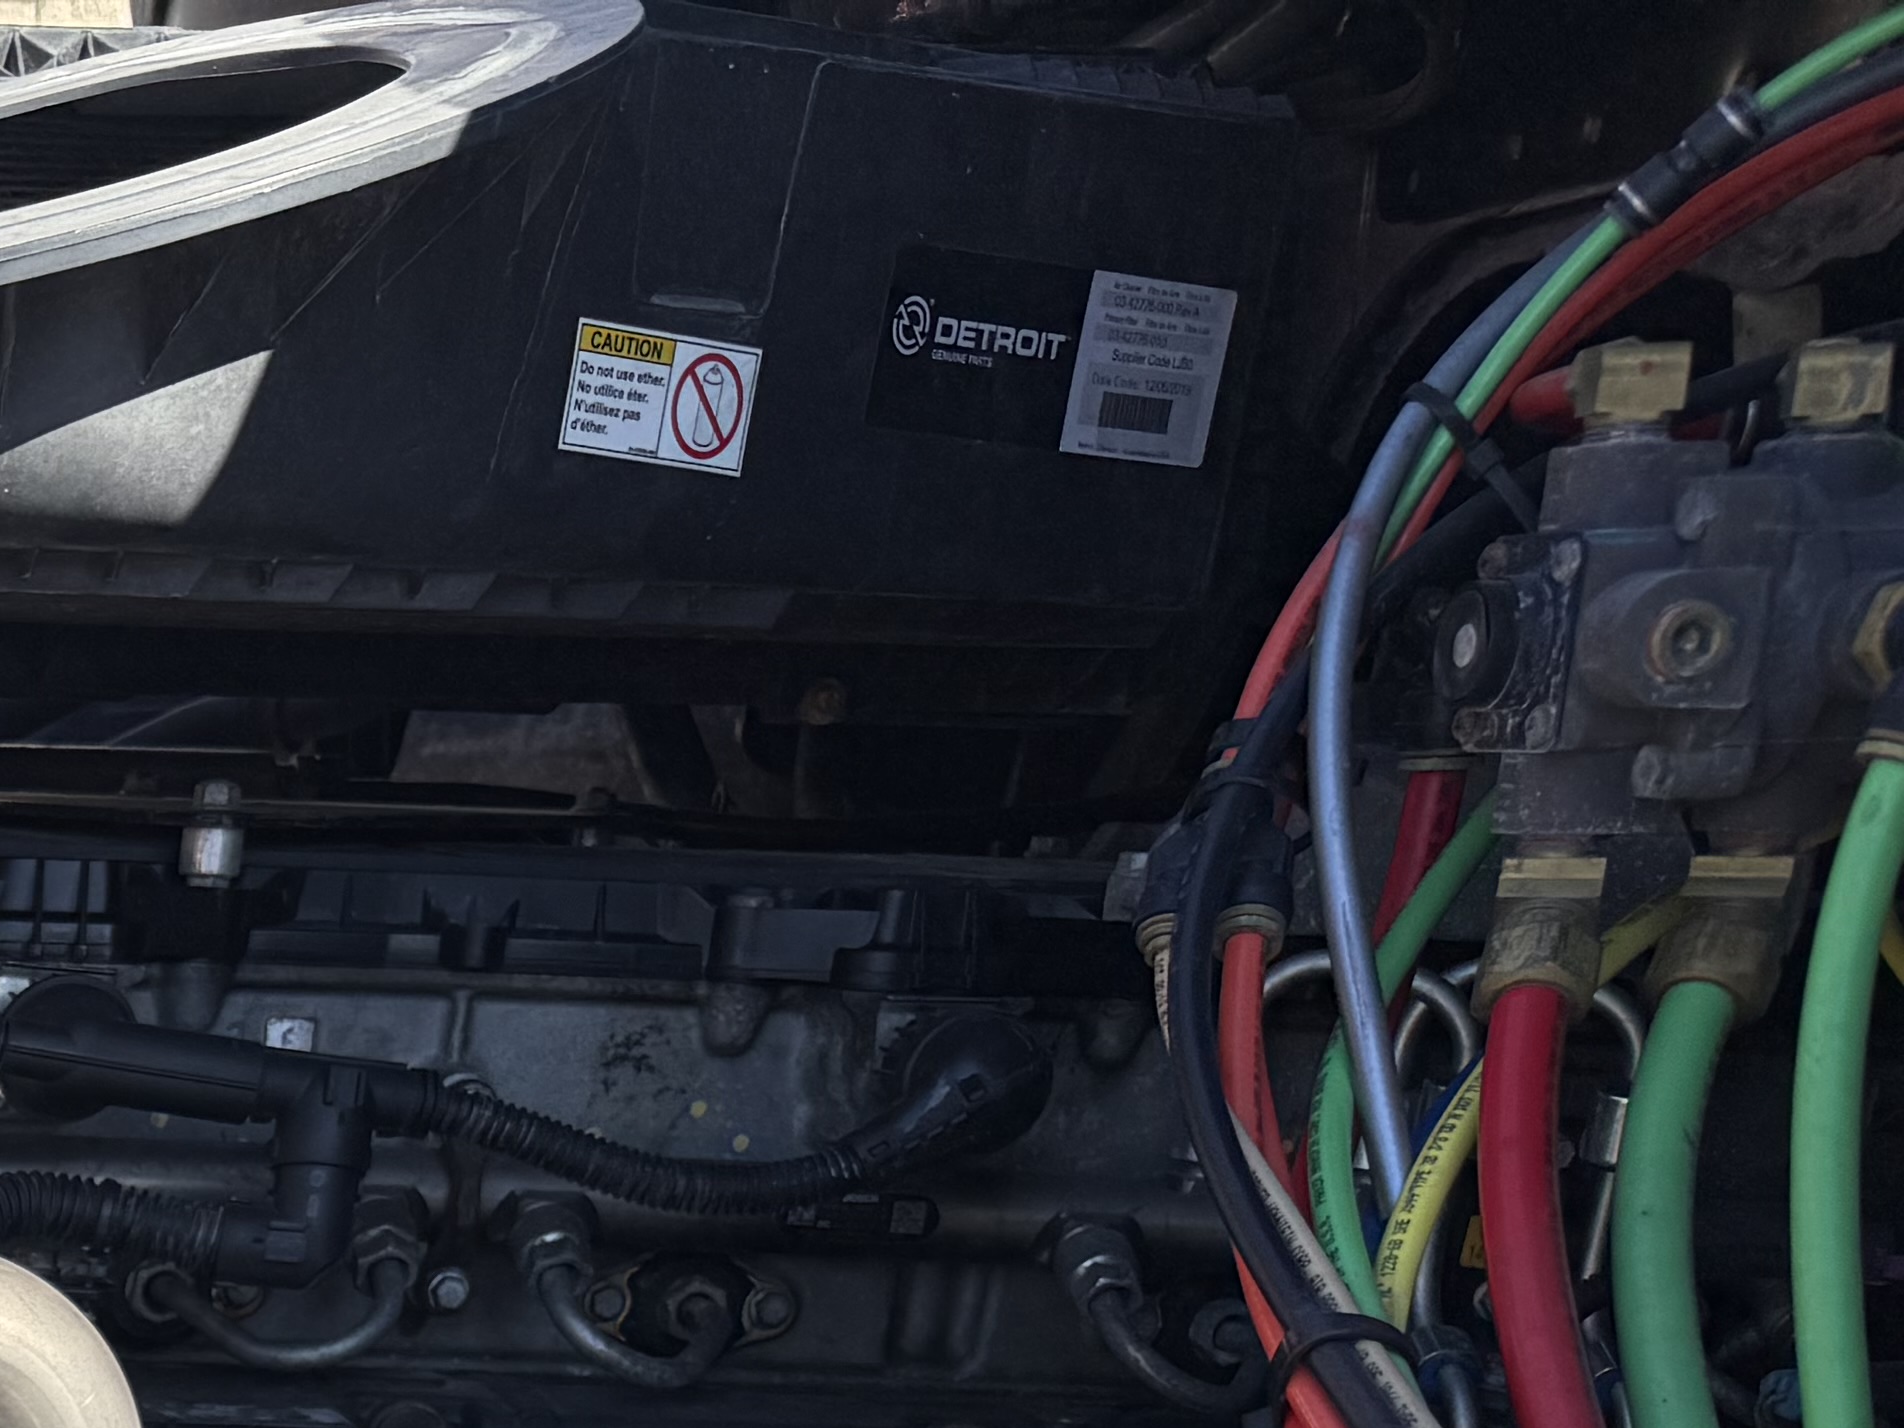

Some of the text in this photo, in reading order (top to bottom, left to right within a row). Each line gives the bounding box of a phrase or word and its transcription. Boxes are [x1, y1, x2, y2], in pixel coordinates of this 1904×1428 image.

[591, 331, 664, 360] CAUTION
[934, 317, 1067, 360] DETROIT
[1112, 349, 1171, 366] Supplier Code
[580, 362, 665, 386] Do not use ether.
[577, 380, 591, 393] No
[622, 409, 641, 422] pas
